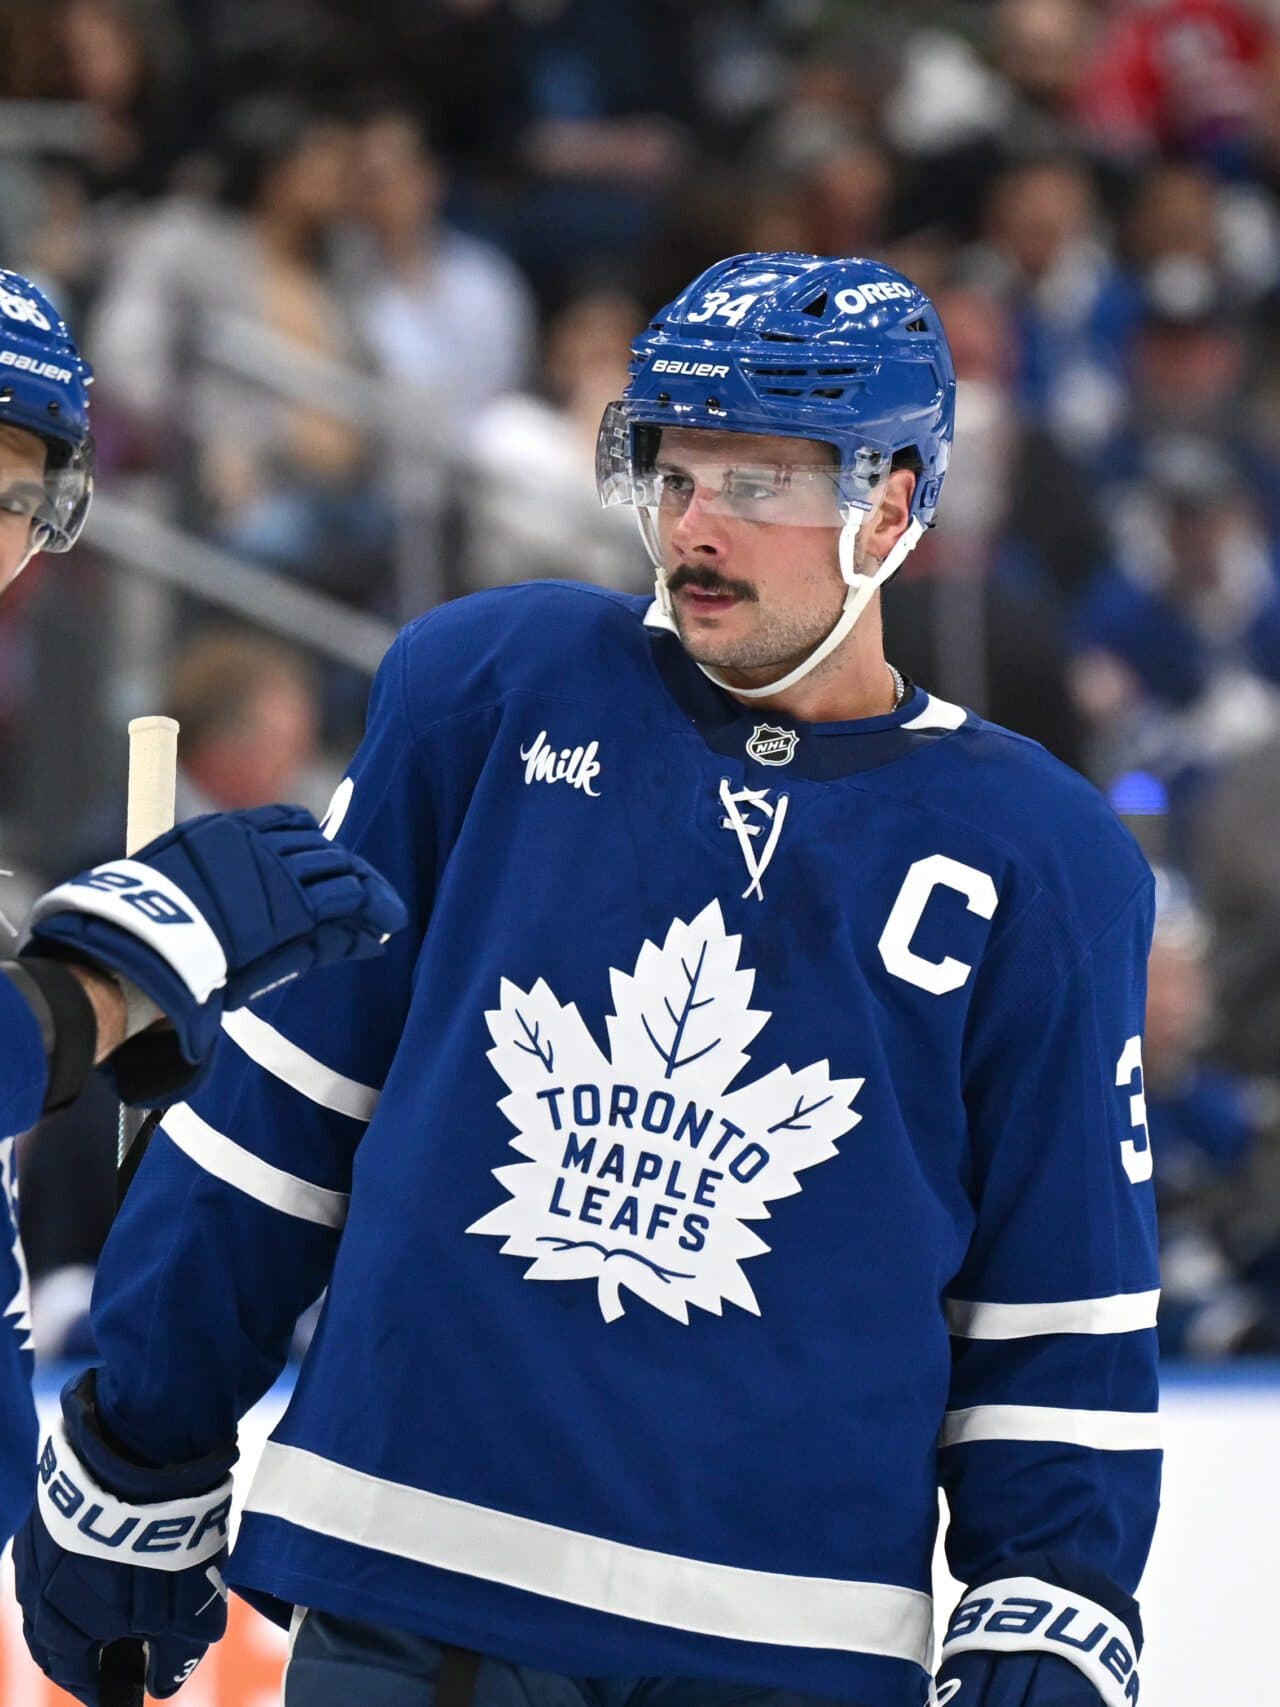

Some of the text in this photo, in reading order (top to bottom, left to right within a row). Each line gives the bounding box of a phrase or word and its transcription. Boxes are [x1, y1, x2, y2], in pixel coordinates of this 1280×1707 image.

[687, 291, 759, 326] 34
[834, 282, 911, 314] OREO
[520, 730, 601, 797] Milk
[756, 738, 787, 754] NHL
[877, 853, 999, 995] C
[536, 1083, 770, 1184] TORONTO
[561, 1131, 724, 1209] MAPLE
[548, 1176, 710, 1253] LEAFS
